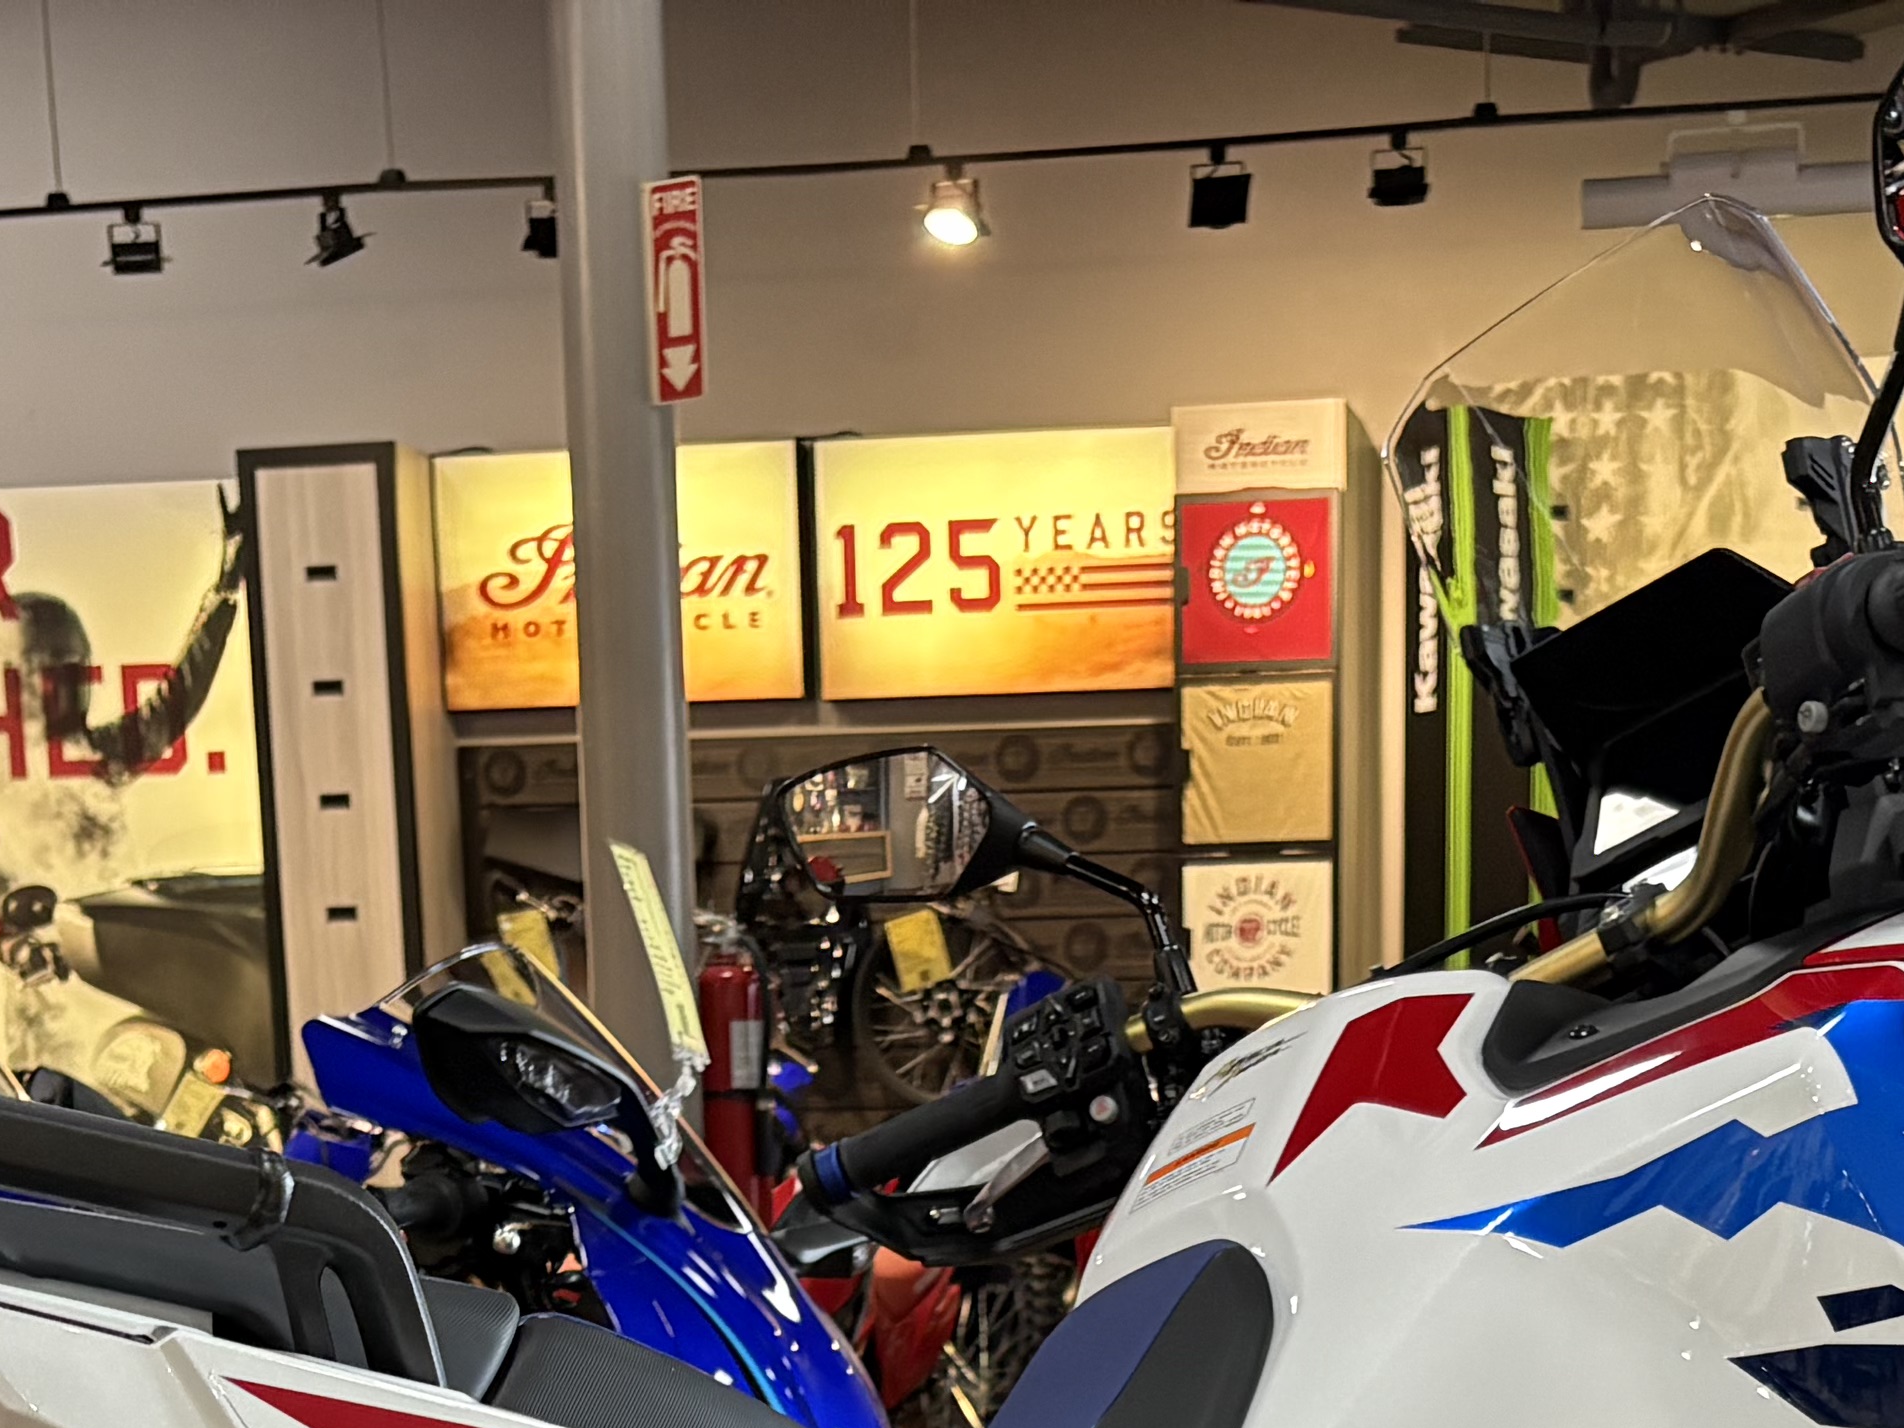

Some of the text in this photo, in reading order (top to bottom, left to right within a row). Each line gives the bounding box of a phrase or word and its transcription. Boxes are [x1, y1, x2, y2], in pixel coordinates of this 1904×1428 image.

[652, 188, 698, 216] FIRE
[1204, 428, 1310, 461] Indian
[1490, 444, 1522, 622] wasaki
[835, 510, 1176, 620] 125 YEARS
[490, 611, 765, 640] MOTCLE
